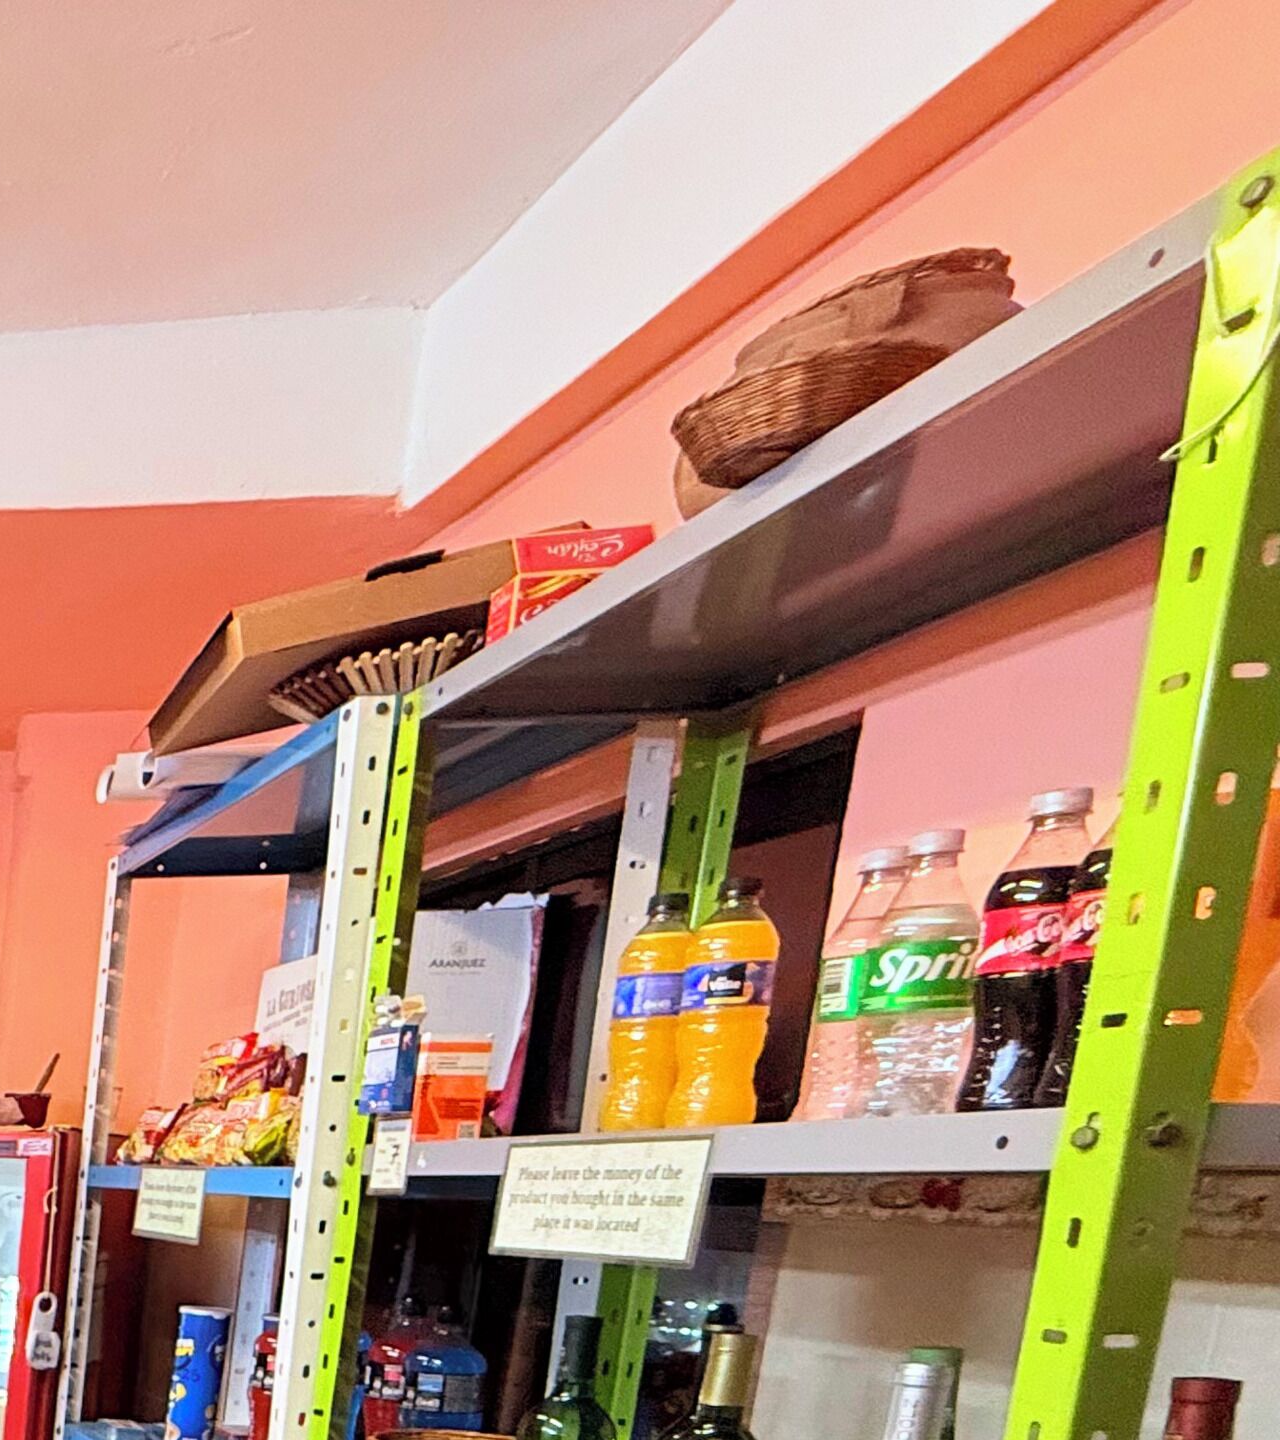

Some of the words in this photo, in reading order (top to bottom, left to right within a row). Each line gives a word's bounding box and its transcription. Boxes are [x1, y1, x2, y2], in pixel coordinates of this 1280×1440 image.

[428, 959, 487, 968] ARANJUEZ
[518, 1166, 549, 1182] Please
[552, 1166, 579, 1181] leave
[582, 1165, 601, 1180] the
[602, 1167, 641, 1184] money
[645, 1164, 658, 1180] of
[661, 1163, 684, 1180] the
[508, 1192, 548, 1207] product
[550, 1195, 569, 1208] you
[570, 1192, 610, 1210] bought
[612, 1193, 624, 1206] in
[627, 1191, 647, 1206] the
[649, 1195, 685, 1207] same
[533, 1215, 561, 1232] place
[562, 1215, 571, 1230] it
[573, 1218, 595, 1231] was
[596, 1217, 640, 1233] located
